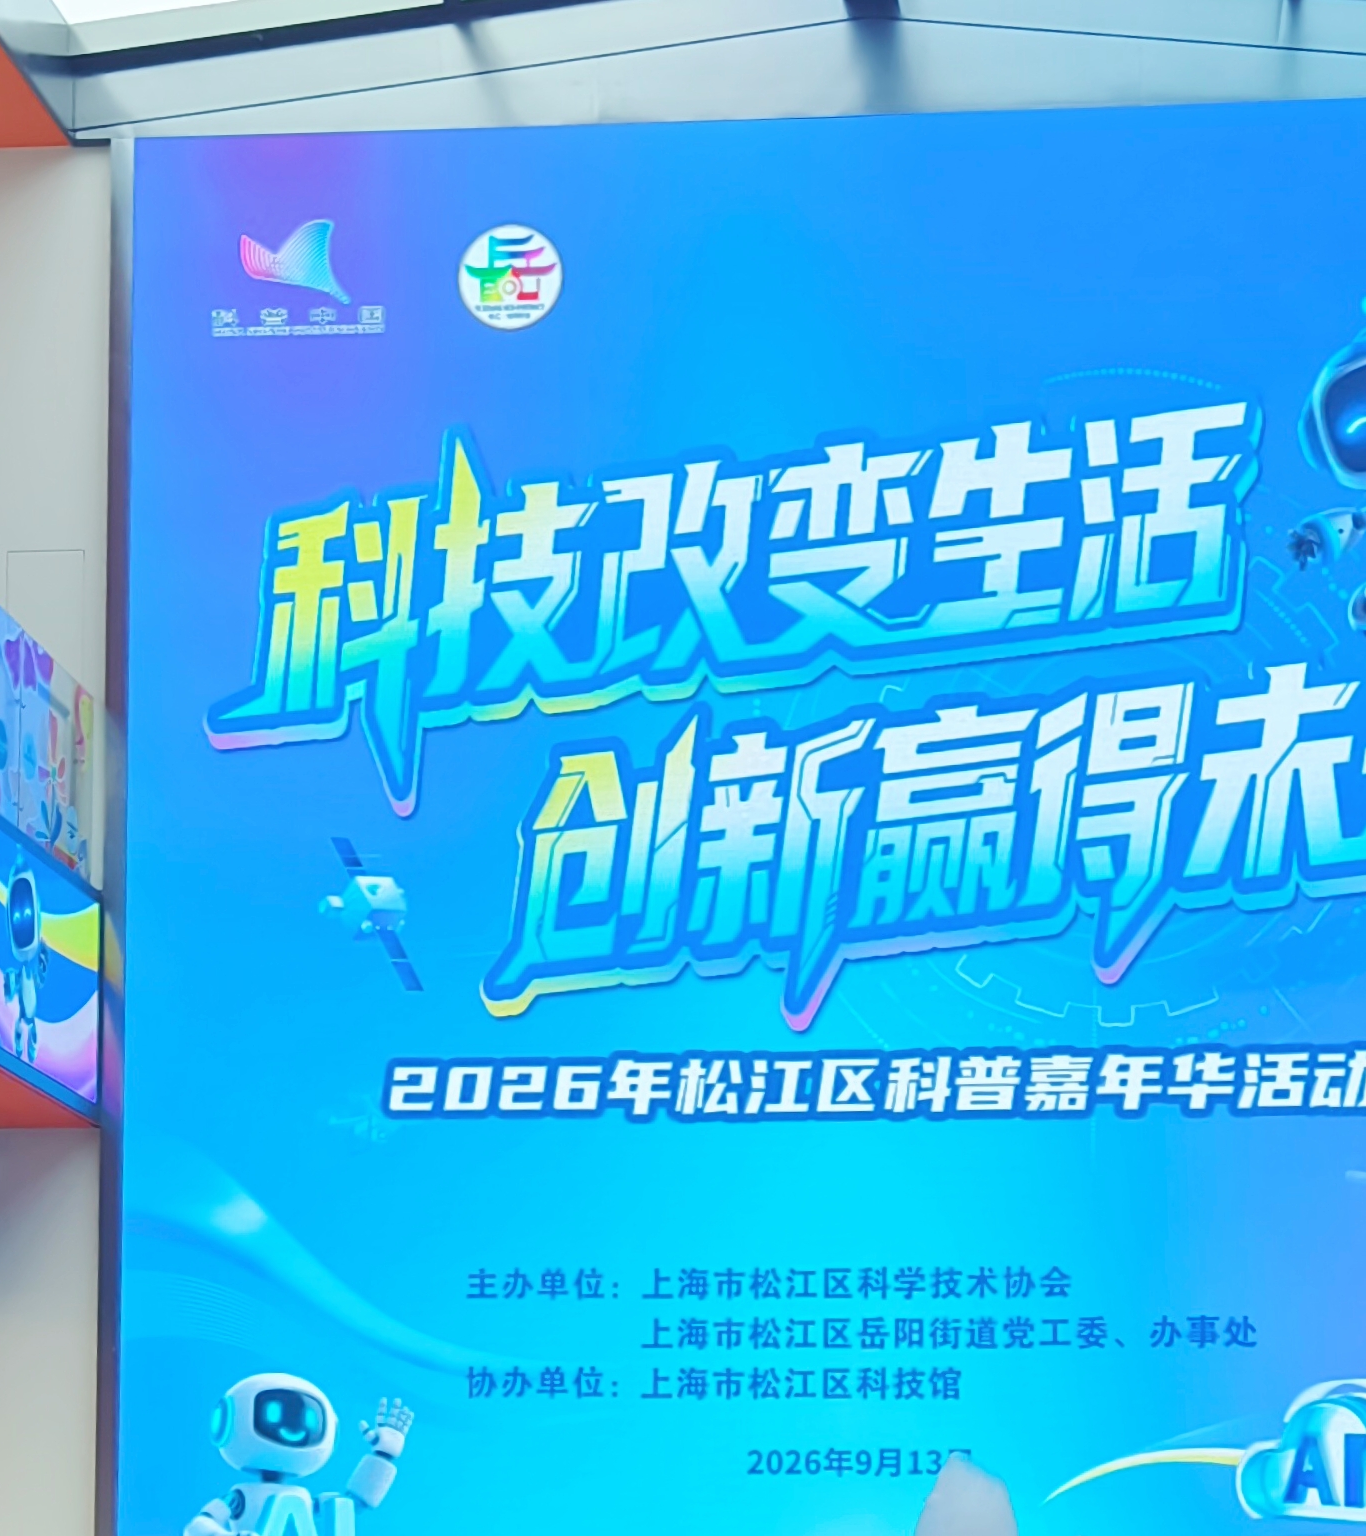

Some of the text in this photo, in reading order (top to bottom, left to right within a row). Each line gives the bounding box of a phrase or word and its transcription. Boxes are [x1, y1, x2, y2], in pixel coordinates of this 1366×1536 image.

[212, 402, 1249, 797] 科技改变生活
[641, 1314, 1259, 1350] 上海市松江区岳阳街道党工委、办事处
[746, 1447, 972, 1478] 2026年9月13
